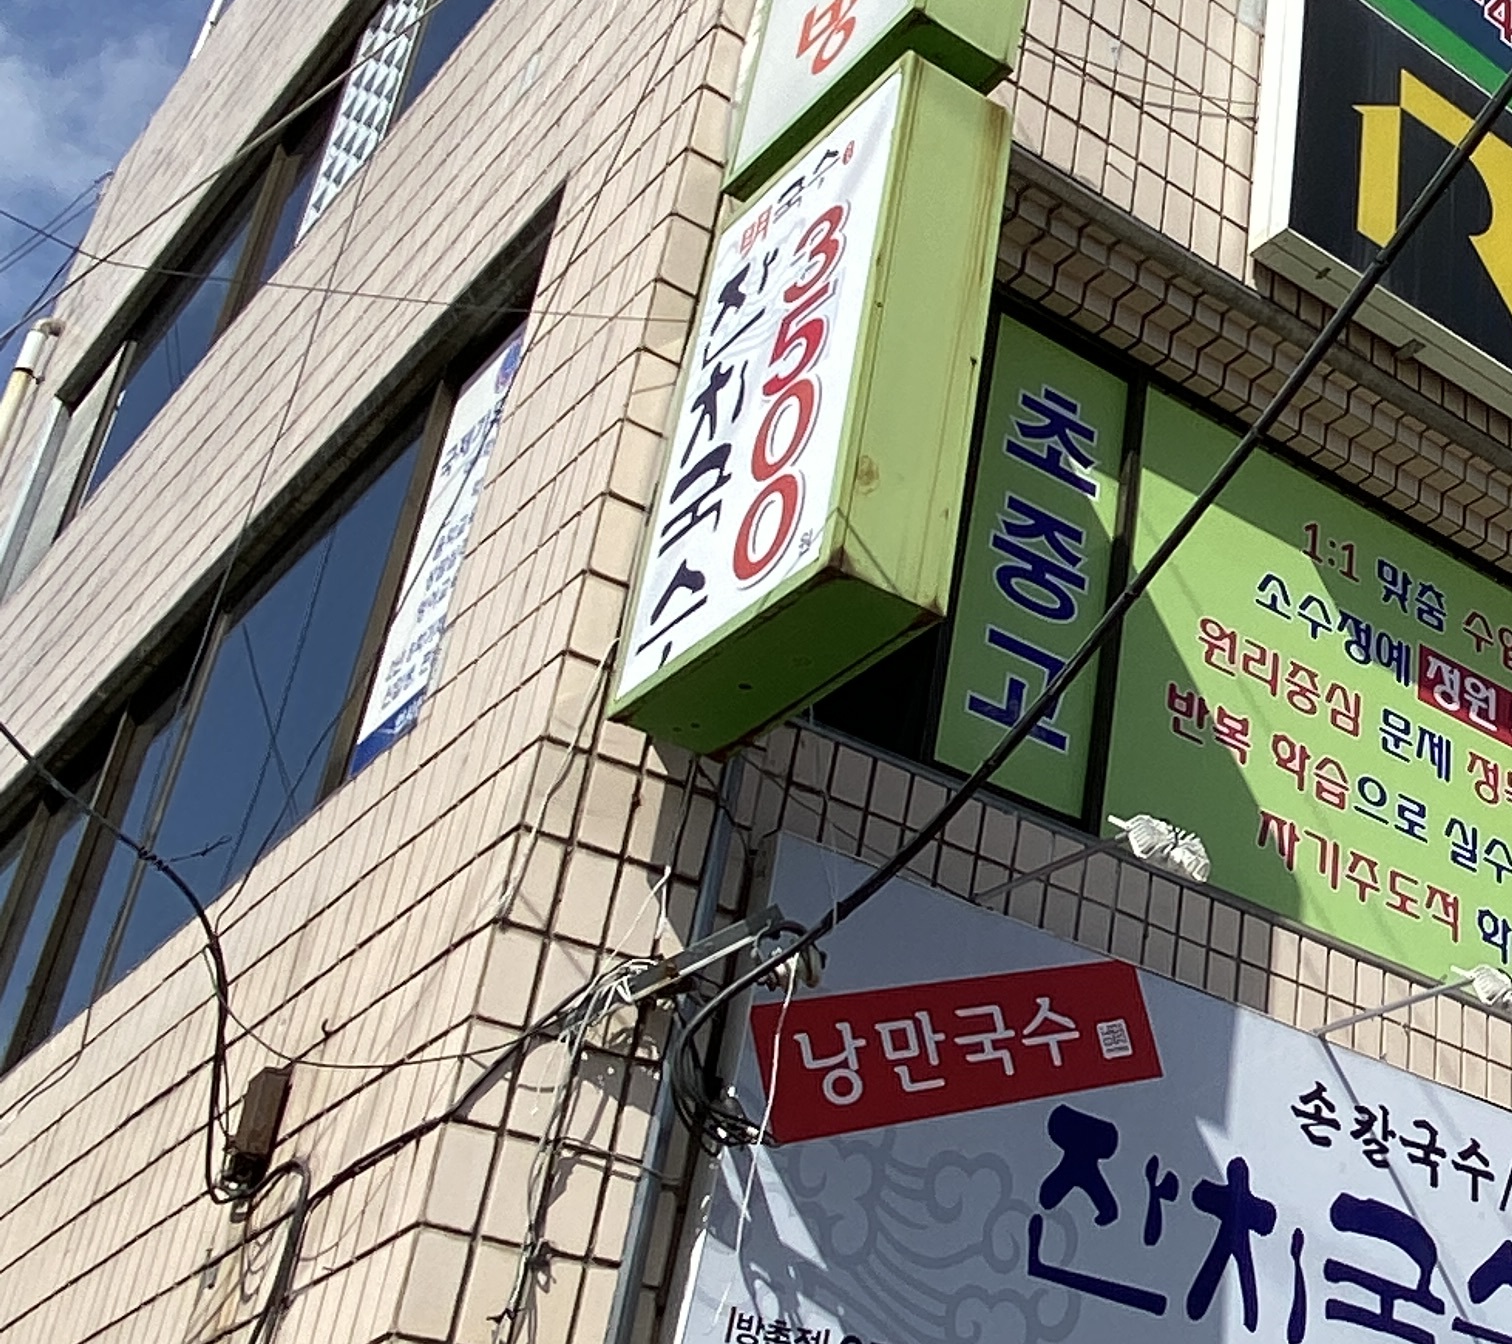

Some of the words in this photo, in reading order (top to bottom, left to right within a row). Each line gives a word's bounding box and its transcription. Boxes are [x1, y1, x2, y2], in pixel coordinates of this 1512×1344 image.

[636, 247, 779, 669] 잔치국수
[732, 201, 850, 586] 3500
[965, 385, 1099, 755] 초중고
[1302, 521, 1362, 583] 1:1
[1376, 556, 1448, 633] 맞춤
[1197, 617, 1362, 738] 원리중심
[1378, 708, 1452, 784] 문제
[1256, 571, 1413, 687] 소수정예
[1423, 650, 1500, 732] 정원
[1166, 682, 1252, 766] 반복
[1270, 732, 1430, 844] 학습으로
[1257, 809, 1460, 943] 자기주도적
[794, 995, 1080, 1107] 낭만국수
